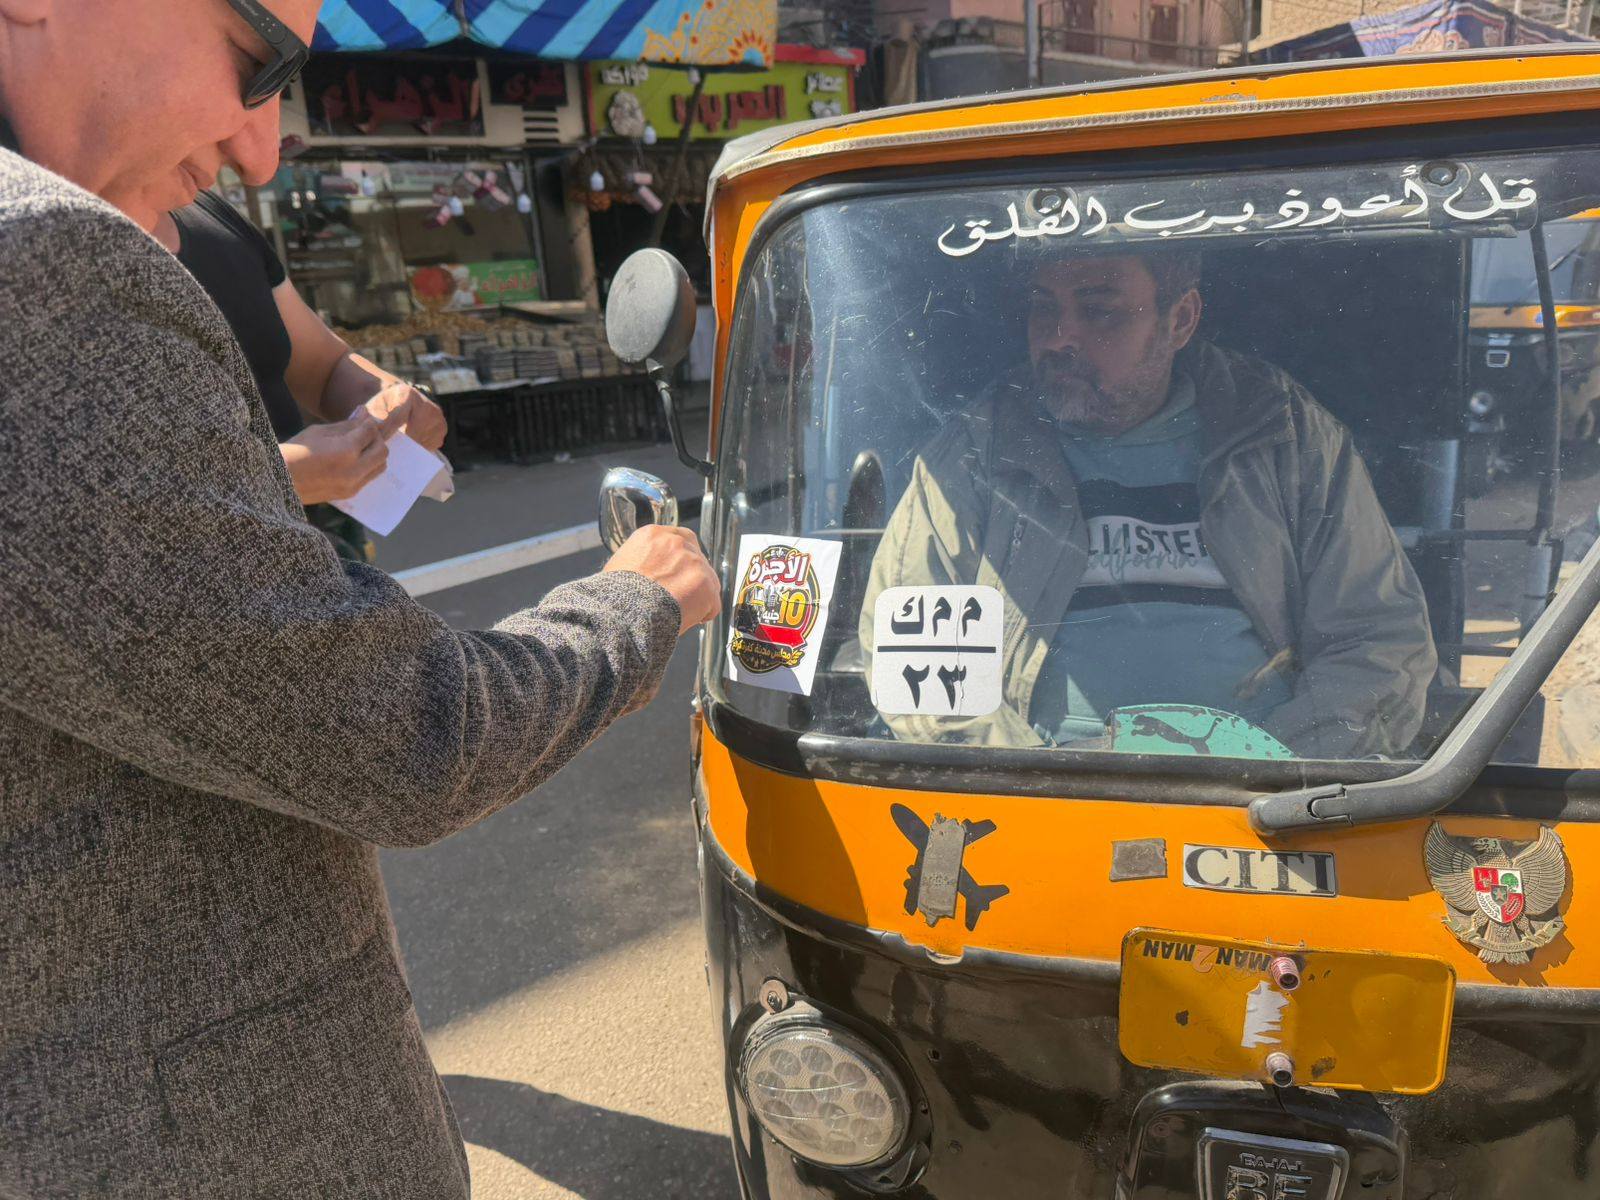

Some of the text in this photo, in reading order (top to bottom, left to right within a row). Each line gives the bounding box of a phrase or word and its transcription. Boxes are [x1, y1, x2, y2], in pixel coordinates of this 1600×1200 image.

[937, 164, 1537, 257] قل أعوذ برب الفلق
[748, 553, 808, 583] الأجرة
[762, 609, 779, 624] جنيه
[777, 590, 806, 626] 10
[902, 664, 967, 710] ٢٣
[1184, 847, 1335, 894] CITI
[1239, 1152, 1305, 1171] BAJAJ
